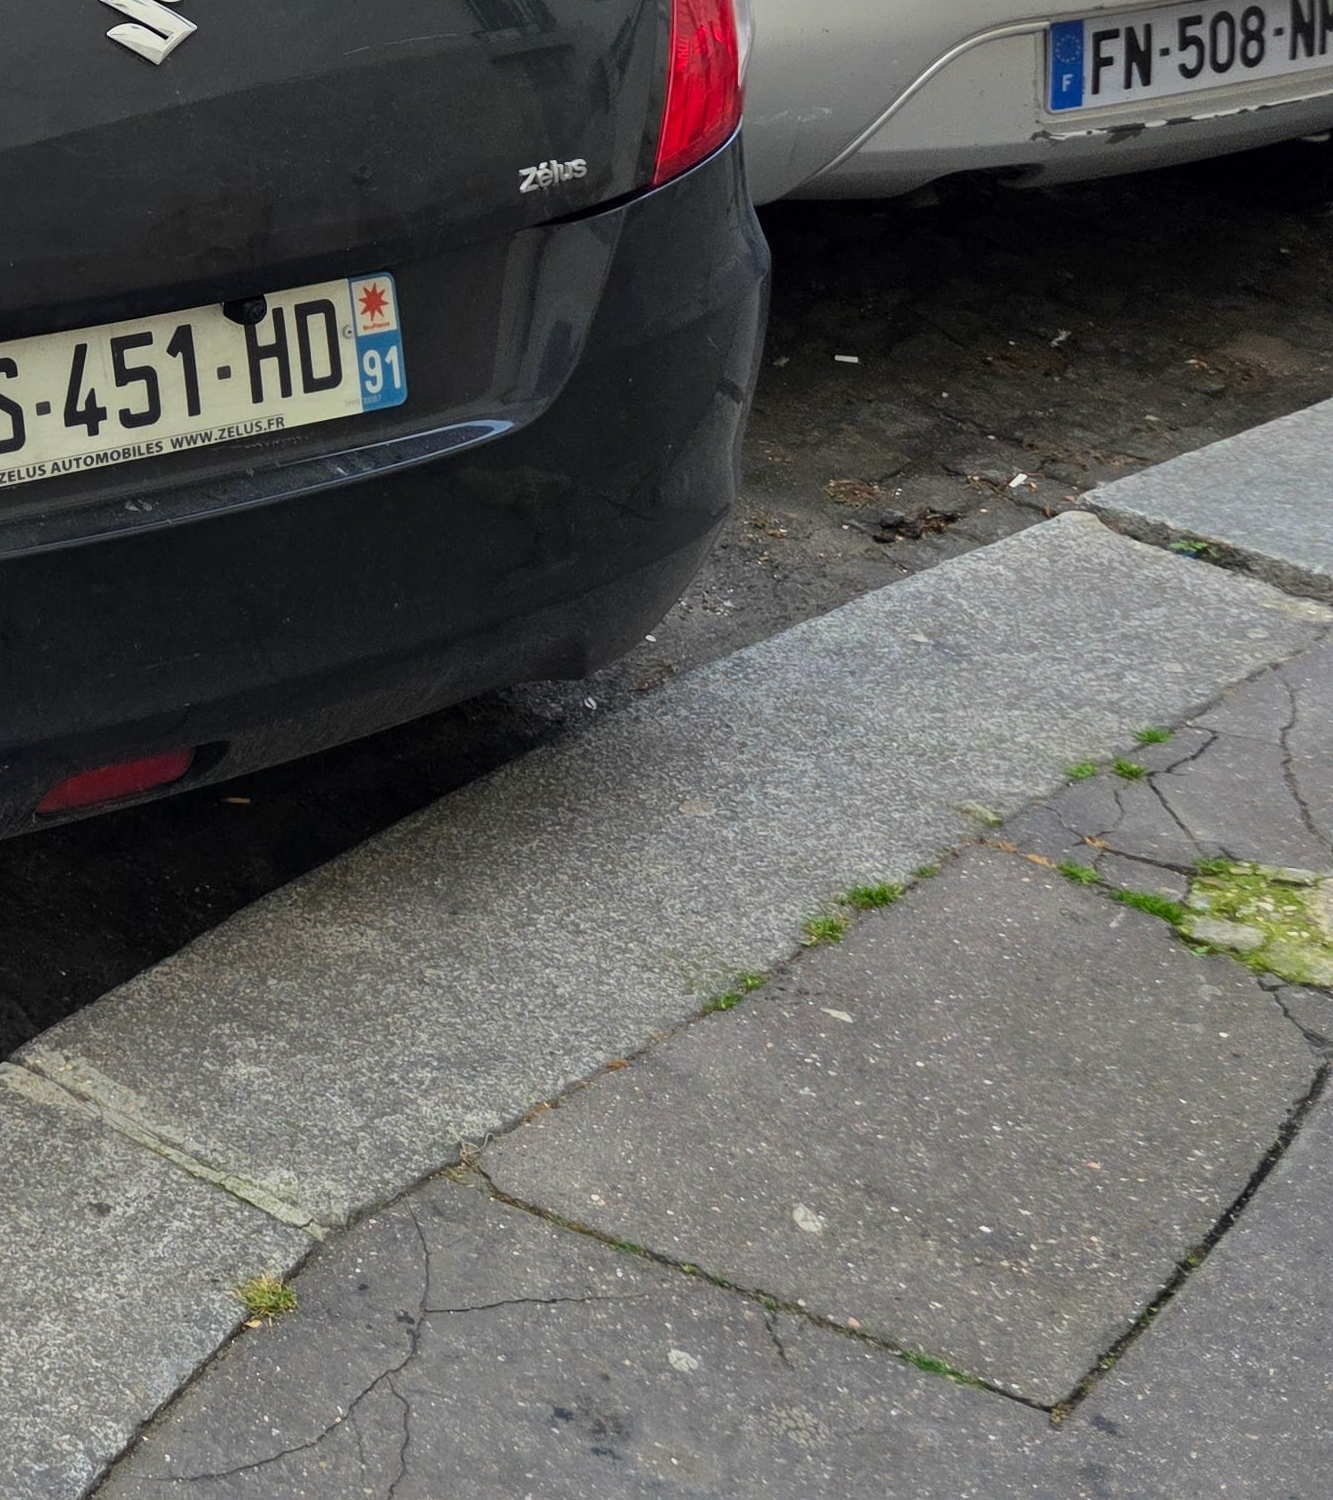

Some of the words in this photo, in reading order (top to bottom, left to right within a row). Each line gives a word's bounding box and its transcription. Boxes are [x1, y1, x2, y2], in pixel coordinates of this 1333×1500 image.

[1062, 74, 1073, 92] F
[362, 345, 402, 395] 91
[50, 440, 164, 475] AUTOMOBILES
[170, 416, 285, 450] WWW.ZELUS.FR
